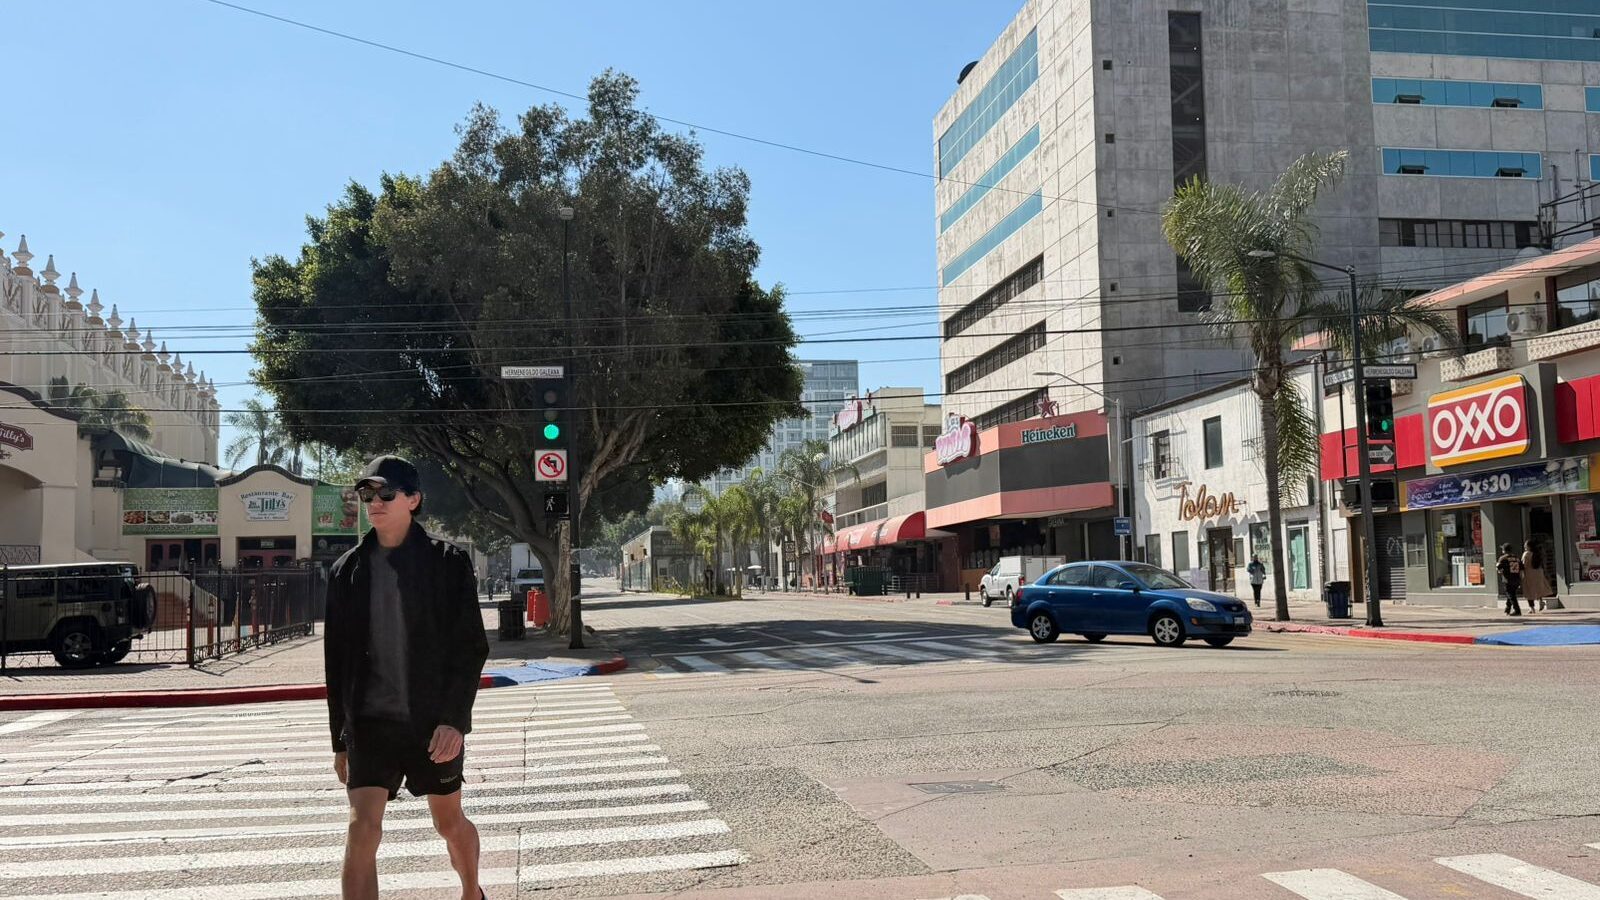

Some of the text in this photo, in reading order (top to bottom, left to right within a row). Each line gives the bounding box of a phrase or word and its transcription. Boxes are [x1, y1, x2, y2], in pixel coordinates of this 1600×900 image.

[1432, 393, 1521, 454] OXXO
[1021, 424, 1076, 444] Heineken
[240, 491, 293, 500] Restaurante Bar
